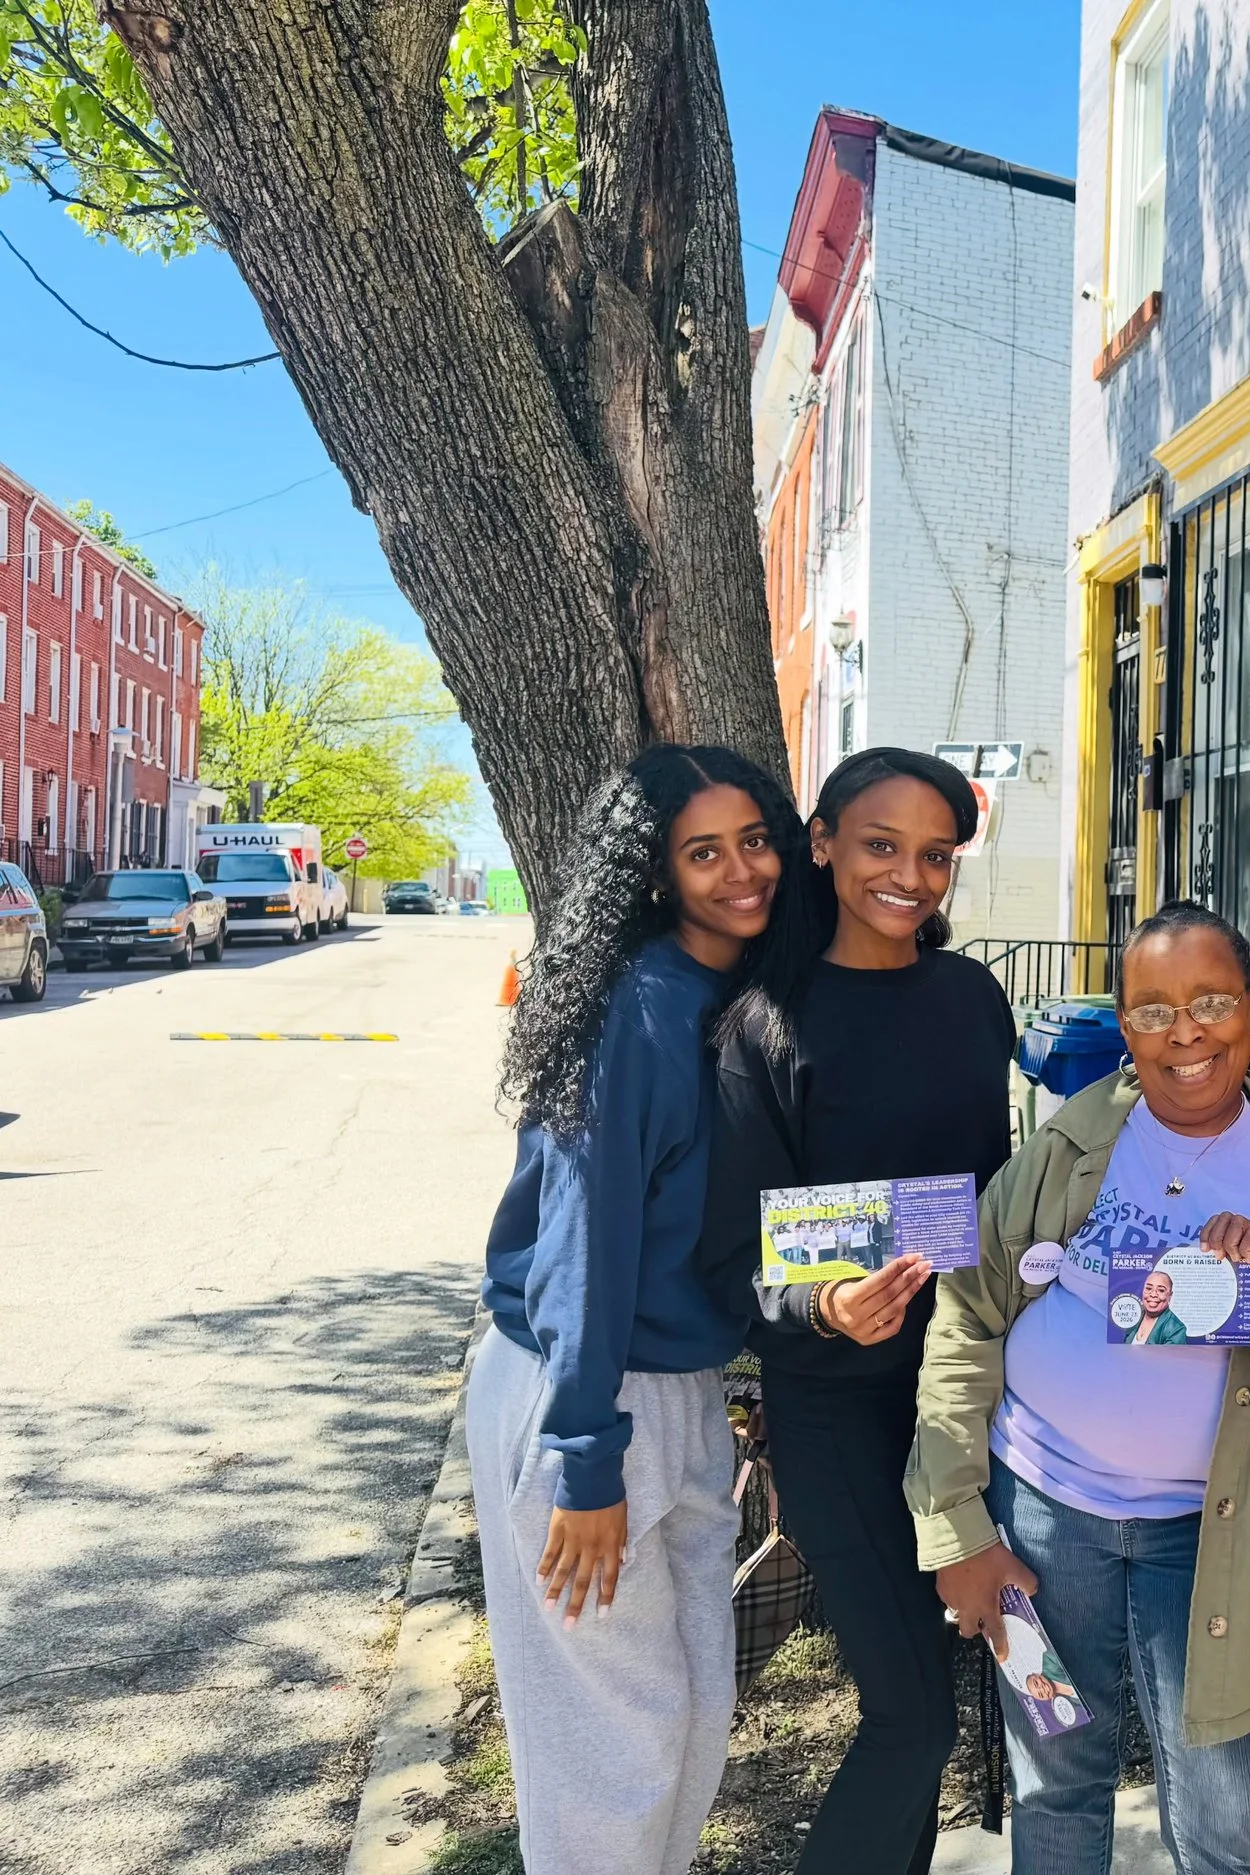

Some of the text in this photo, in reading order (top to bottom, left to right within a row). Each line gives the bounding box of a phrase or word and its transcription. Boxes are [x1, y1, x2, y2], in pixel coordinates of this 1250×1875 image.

[212, 836, 286, 846] U-HAUL
[931, 1177, 968, 1185] LEADERSHIP
[768, 1197, 811, 1210] YOUR
[811, 1193, 855, 1207] VOICE
[857, 1190, 886, 1202] FOR
[767, 1202, 858, 1225] DISTRICT
[863, 1199, 889, 1215] 40
[1023, 1261, 1056, 1270] PARKER
[1112, 1258, 1145, 1266] PARKER
